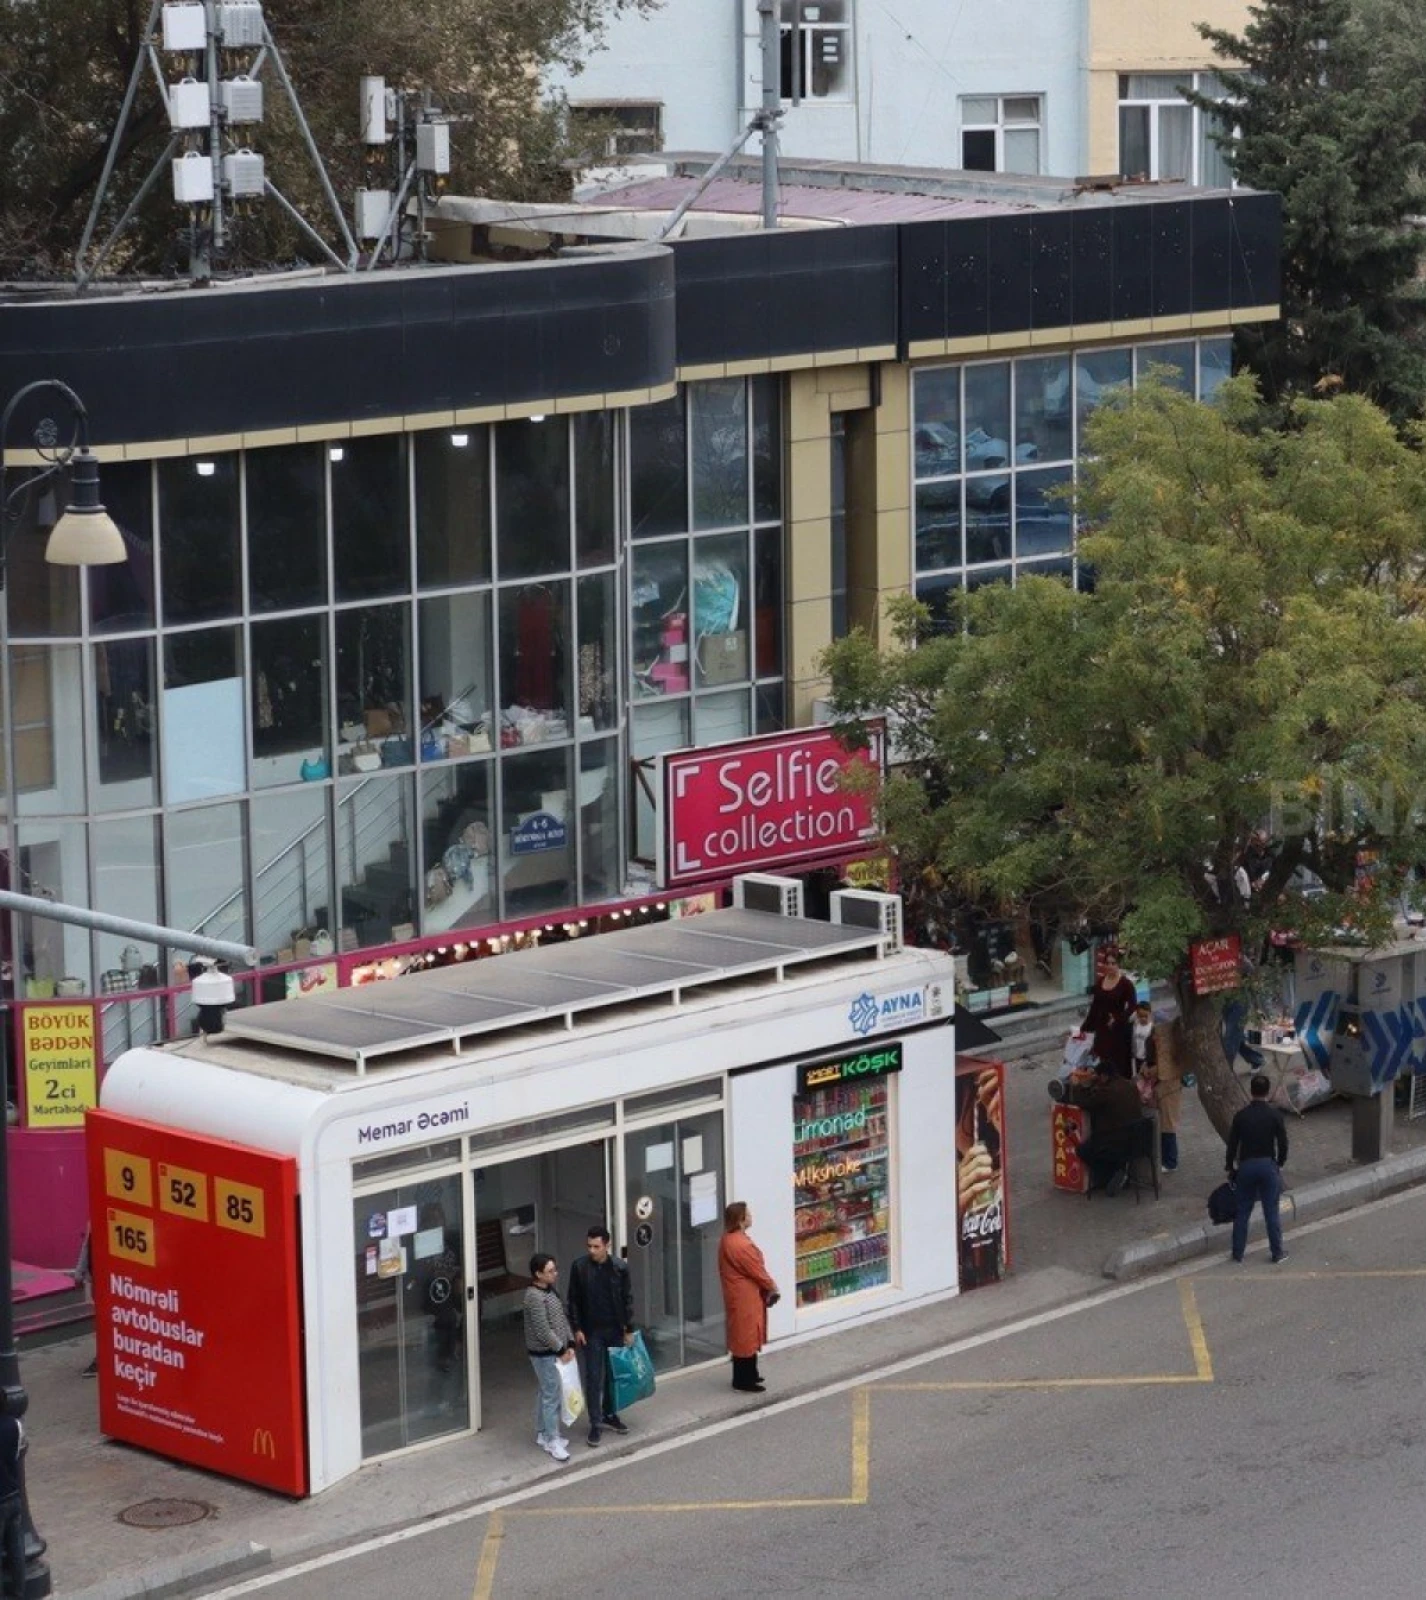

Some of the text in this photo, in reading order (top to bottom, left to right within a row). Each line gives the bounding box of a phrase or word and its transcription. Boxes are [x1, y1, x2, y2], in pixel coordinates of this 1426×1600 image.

[719, 750, 840, 813] Selfie
[704, 805, 854, 857] collection
[28, 1014, 89, 1031] BÖYÜK
[881, 992, 921, 1015] AYNA
[30, 1036, 93, 1051] BƏDƏN
[29, 1057, 91, 1073] Geyimləri
[842, 1050, 898, 1077] KÖŞK
[358, 1101, 469, 1144] Memar Əcəmi
[793, 1104, 866, 1143] Limonad
[1055, 1112, 1067, 1177] AÇAR
[121, 1167, 254, 1223] 9 52 85
[115, 1225, 147, 1253] 165
[110, 1273, 179, 1313] Nömrəli
[112, 1305, 204, 1348] avtobuslar
[113, 1327, 185, 1369] buradan
[114, 1354, 157, 1391] keçir
